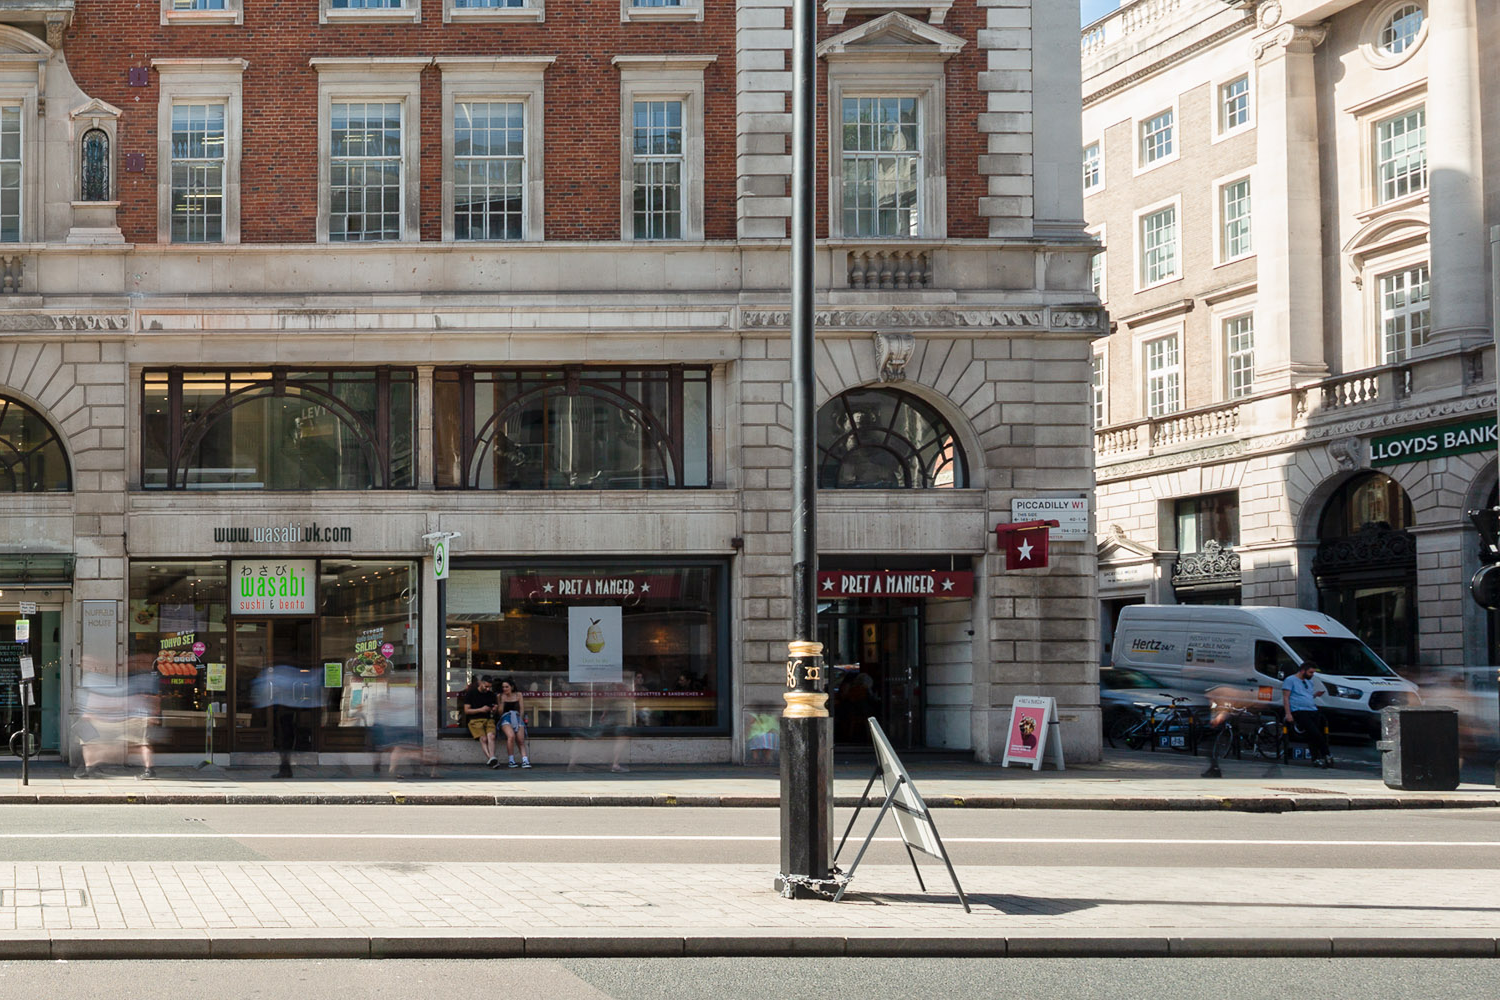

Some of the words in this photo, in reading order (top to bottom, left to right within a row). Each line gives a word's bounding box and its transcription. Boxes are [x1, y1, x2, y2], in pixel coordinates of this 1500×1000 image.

[1370, 435, 1438, 460] LLOYDS
[1444, 424, 1498, 448] BANK
[214, 522, 352, 542] www.wasabi.uk.com
[240, 565, 287, 576] わさび
[241, 568, 305, 597] wasabi
[559, 579, 583, 595] PRET
[585, 579, 592, 595] A
[595, 579, 635, 595] MANGER
[841, 575, 871, 593] PRET
[874, 576, 881, 593] A
[886, 575, 935, 593] MANGER
[240, 600, 265, 610] sushi
[270, 600, 274, 610] &
[279, 600, 305, 610] bento
[183, 634, 195, 645] SET
[356, 640, 377, 653] SALAD
[1132, 639, 1161, 650] Hertz
